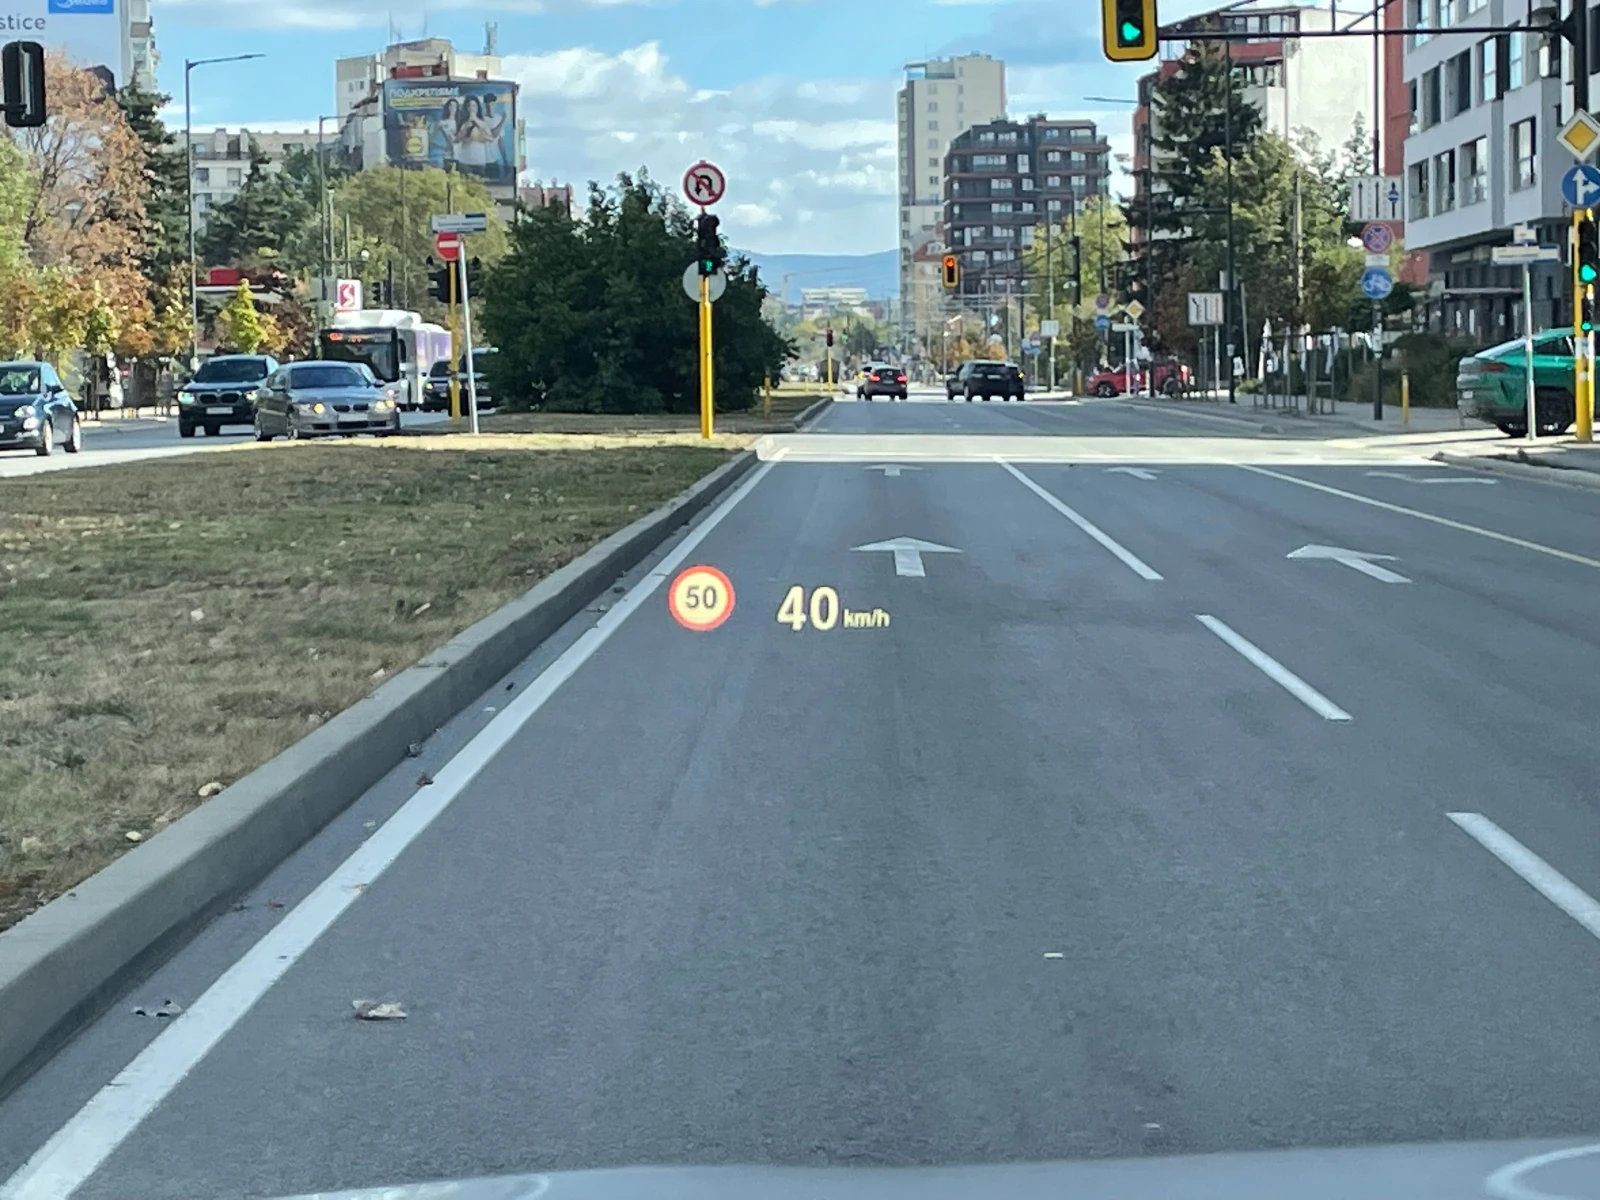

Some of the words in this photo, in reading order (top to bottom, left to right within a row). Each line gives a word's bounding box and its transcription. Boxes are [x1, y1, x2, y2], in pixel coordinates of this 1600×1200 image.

[685, 585, 718, 610] 50
[776, 585, 839, 631] 40
[843, 608, 891, 629] km/h
